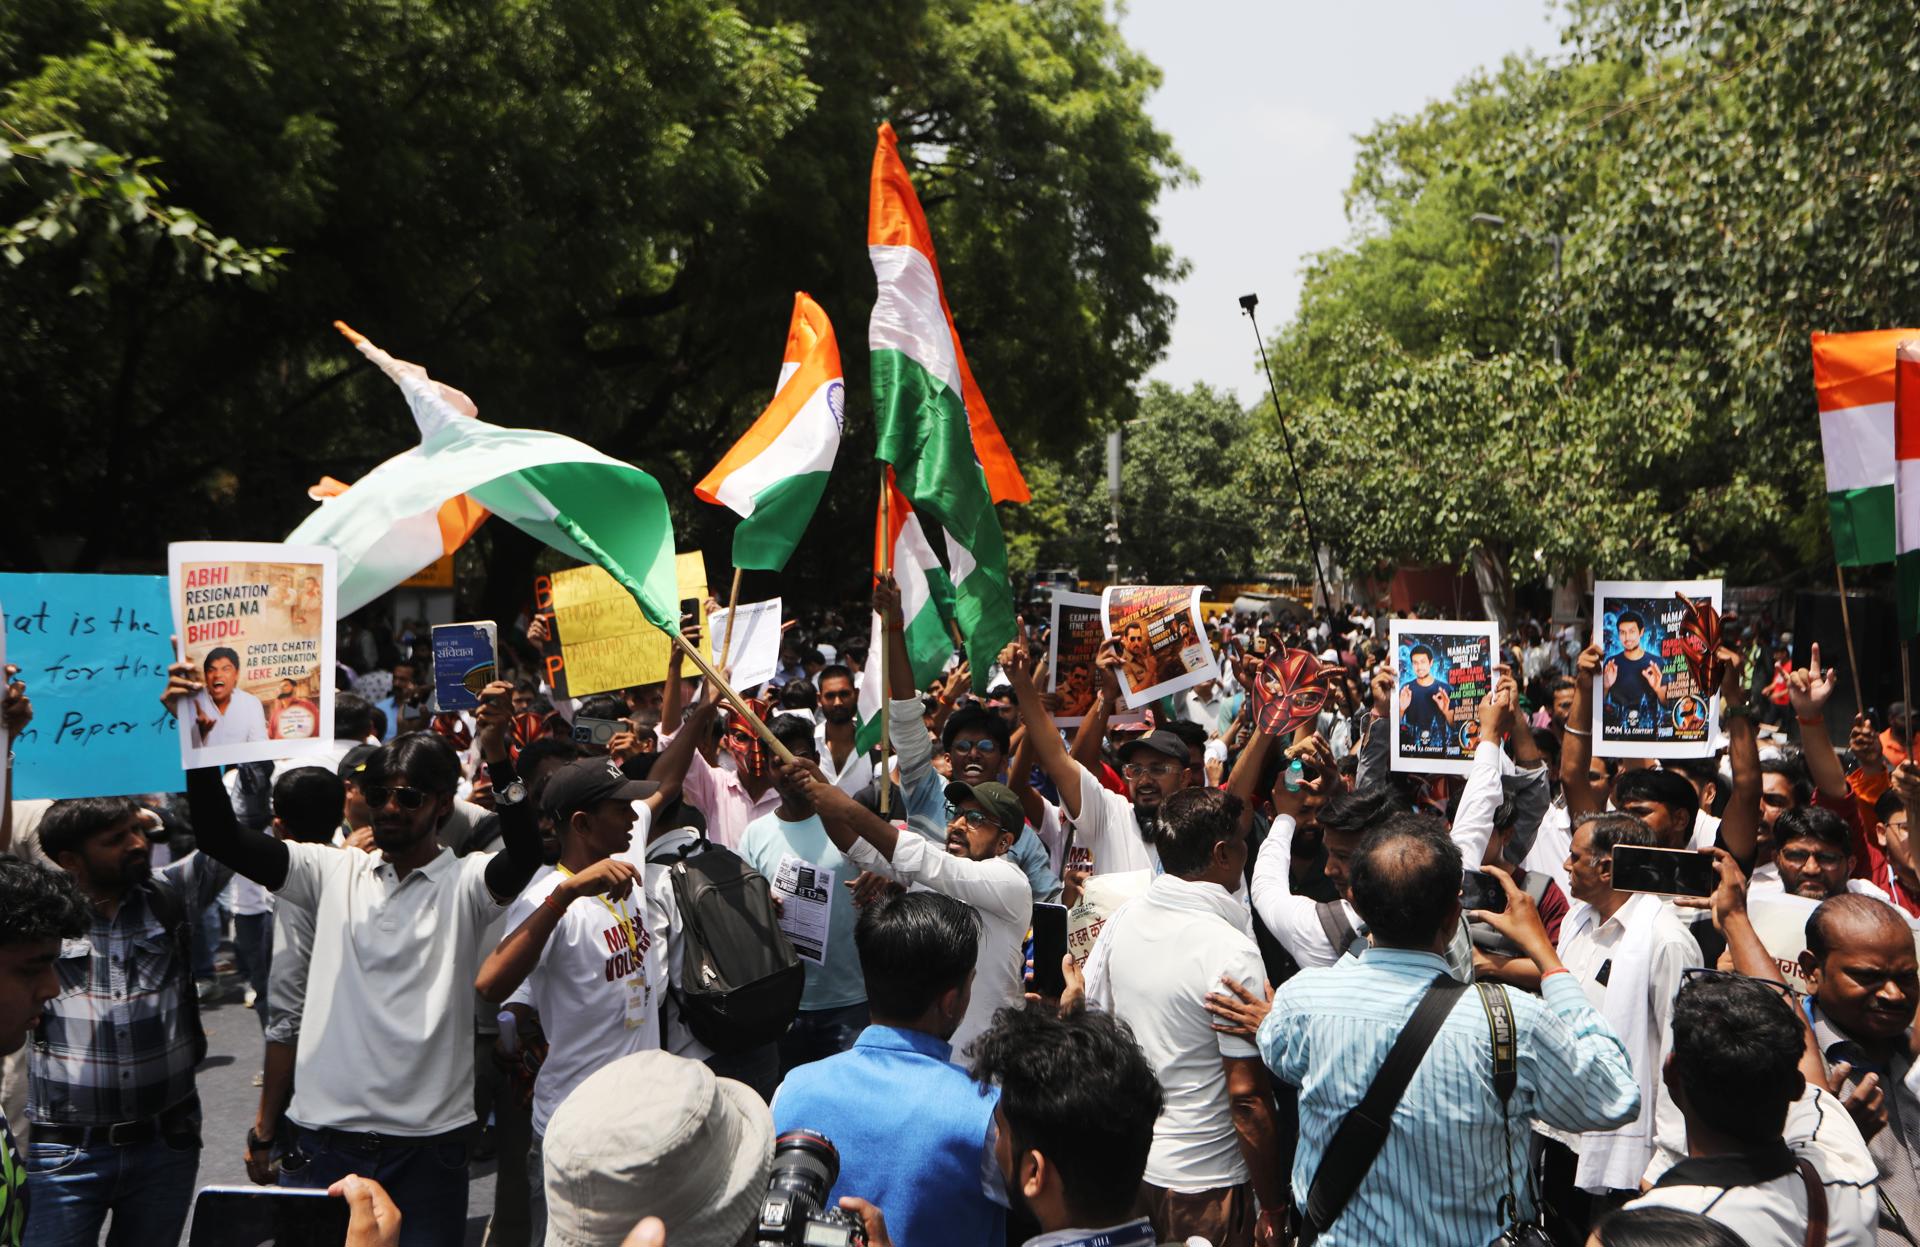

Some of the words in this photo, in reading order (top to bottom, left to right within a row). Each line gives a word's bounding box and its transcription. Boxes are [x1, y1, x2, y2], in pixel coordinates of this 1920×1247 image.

[186, 566, 229, 589] ABHI
[186, 584, 269, 606] RESIGNATION
[70, 611, 97, 637] is
[109, 607, 160, 636] the
[187, 602, 236, 625] AAEGA
[240, 600, 259, 616] NA
[1070, 614, 1088, 622] EXAM
[188, 619, 245, 644] BHIDU.
[1070, 622, 1084, 630] ITNE
[248, 644, 278, 656] CHOTA
[282, 640, 316, 652] CHATRI
[1448, 644, 1482, 656] NAMASTEY
[44, 654, 104, 683] for
[113, 654, 167, 681] the
[246, 656, 258, 668] AB
[260, 652, 318, 666] RESIGNATION
[248, 668, 272, 680] LEKE
[274, 664, 310, 678] JAEGA.
[54, 711, 139, 748] Paper
[1632, 728, 1654, 736] CONTENT
[1075, 926, 1091, 946] हम
[1491, 1005, 1510, 1043] NPS
